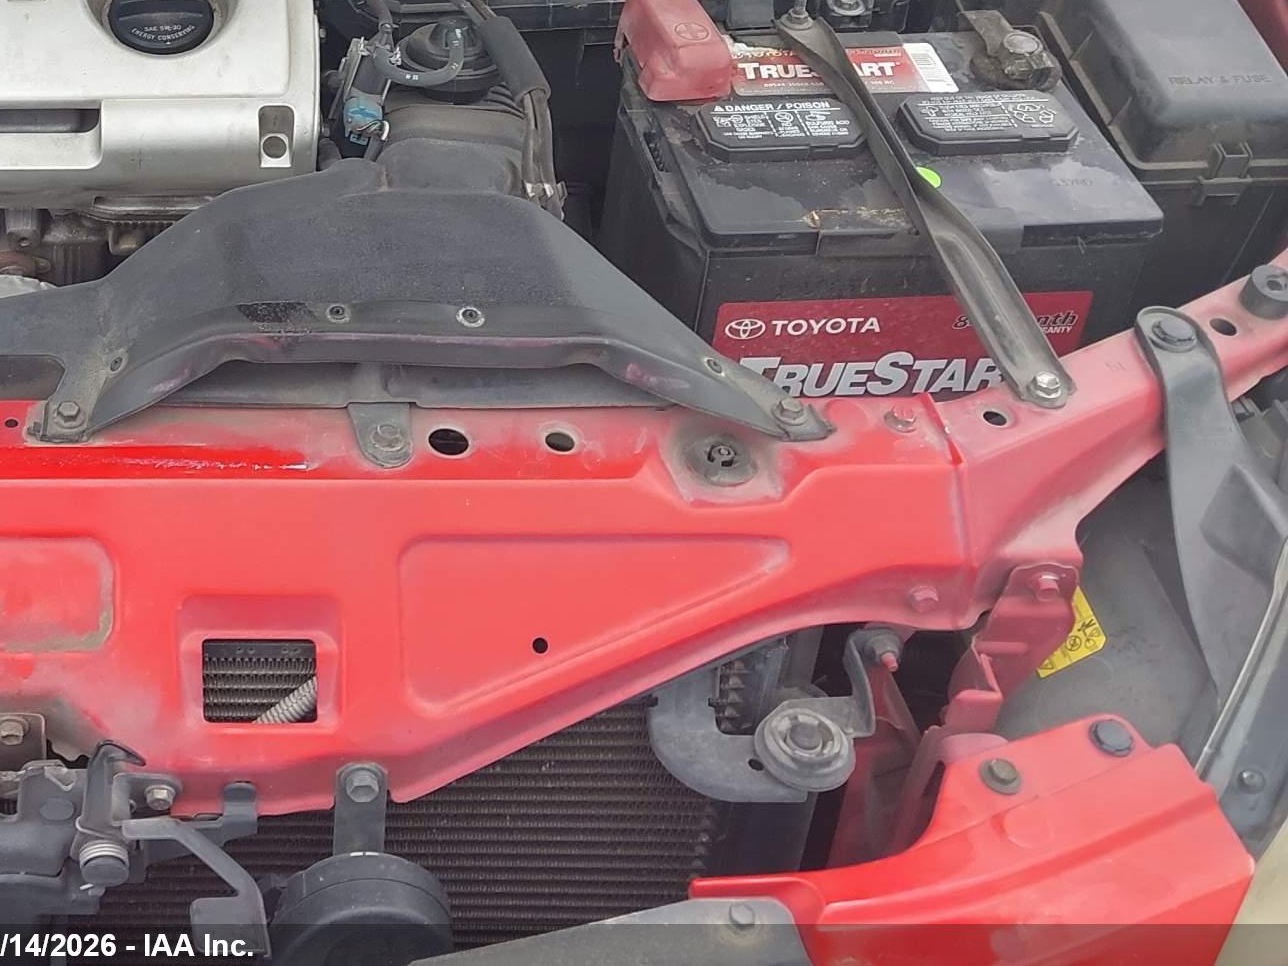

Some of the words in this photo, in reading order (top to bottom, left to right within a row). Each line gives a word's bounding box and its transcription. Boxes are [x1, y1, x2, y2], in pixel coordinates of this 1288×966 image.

[725, 103, 774, 112] DANGER
[786, 101, 830, 110] POISON
[771, 317, 881, 336] TOYOTA
[740, 351, 1002, 397] TRUESTAR
